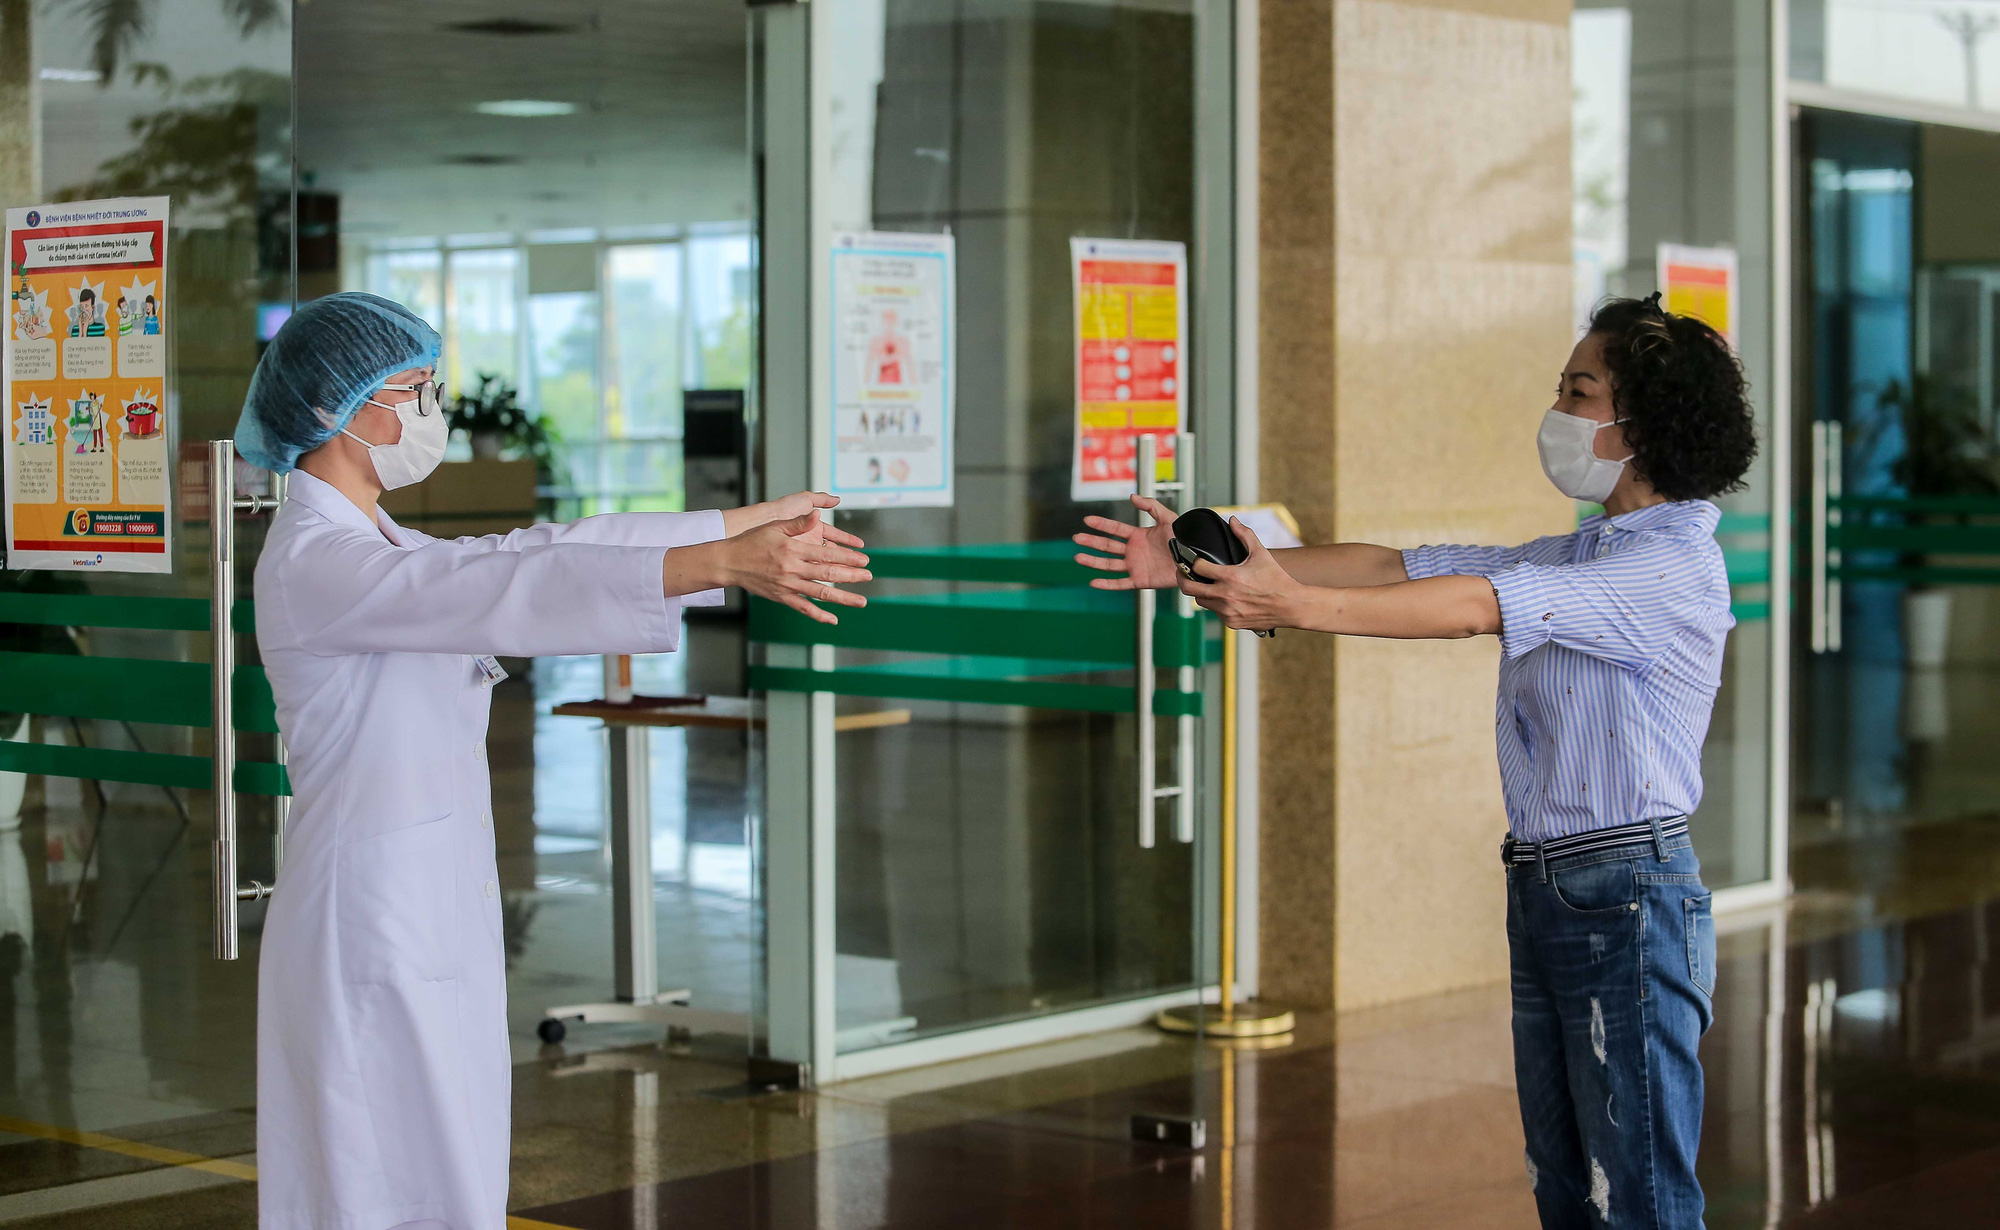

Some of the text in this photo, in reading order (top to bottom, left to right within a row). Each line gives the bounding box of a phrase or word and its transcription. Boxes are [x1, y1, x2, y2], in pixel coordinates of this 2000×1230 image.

[46, 209, 147, 224] BỆNH VIỆN BỆNH NHIỆT ĐỚI TRUNG ƯƠNG
